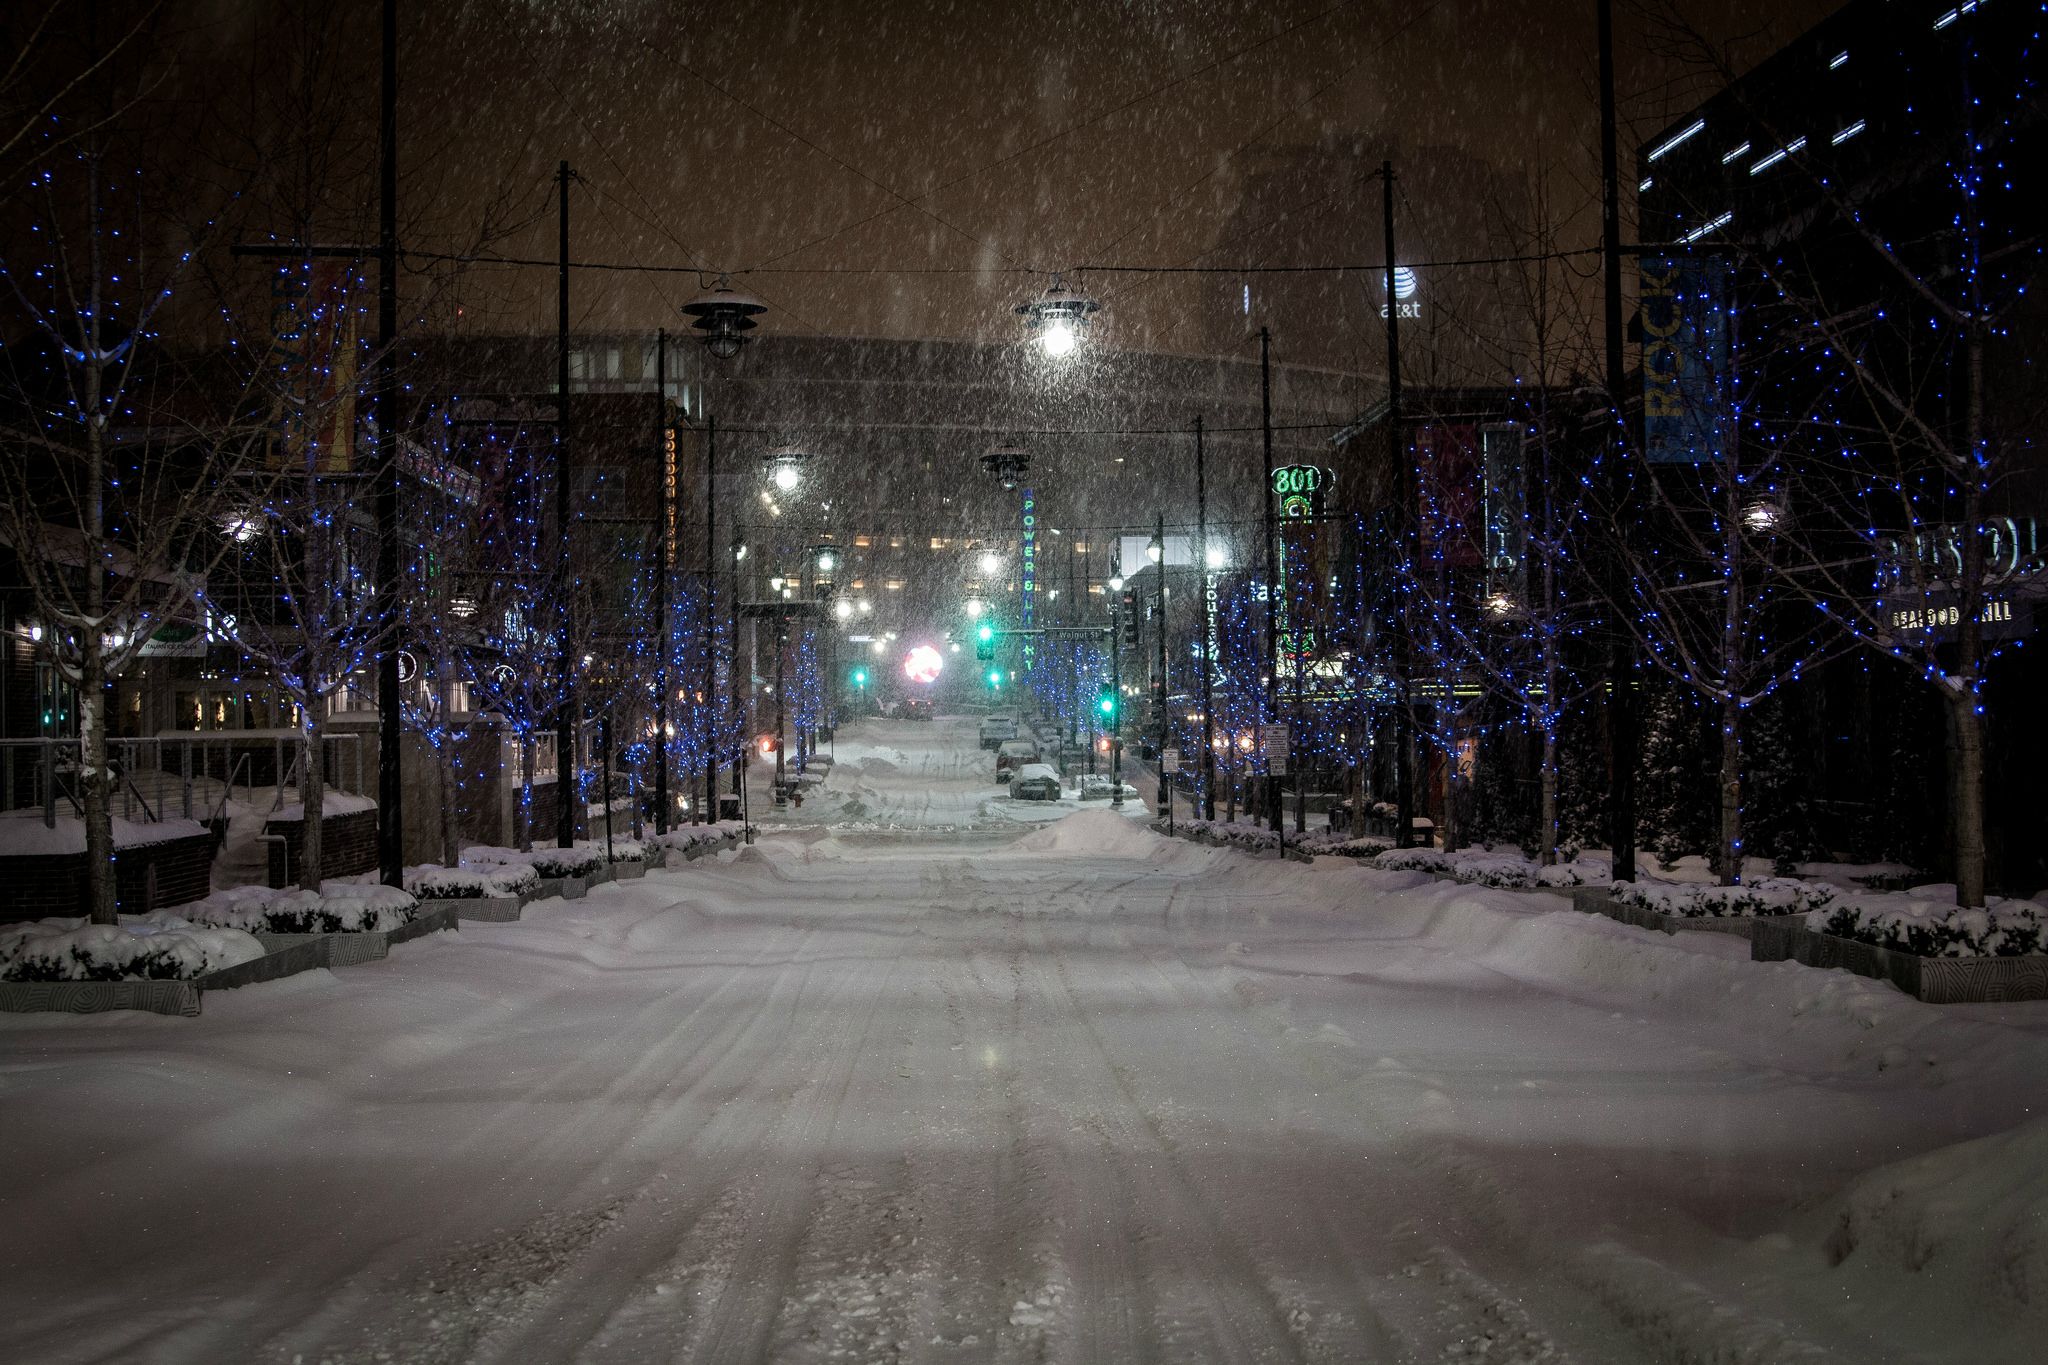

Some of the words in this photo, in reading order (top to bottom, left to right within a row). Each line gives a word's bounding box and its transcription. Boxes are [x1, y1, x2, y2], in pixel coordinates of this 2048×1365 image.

[1381, 301, 1421, 318] at&t
[1640, 269, 1683, 417] ROCK
[1276, 468, 1316, 493] 801
[1023, 500, 1034, 572] POWER
[1060, 631, 1088, 639] Walnut
